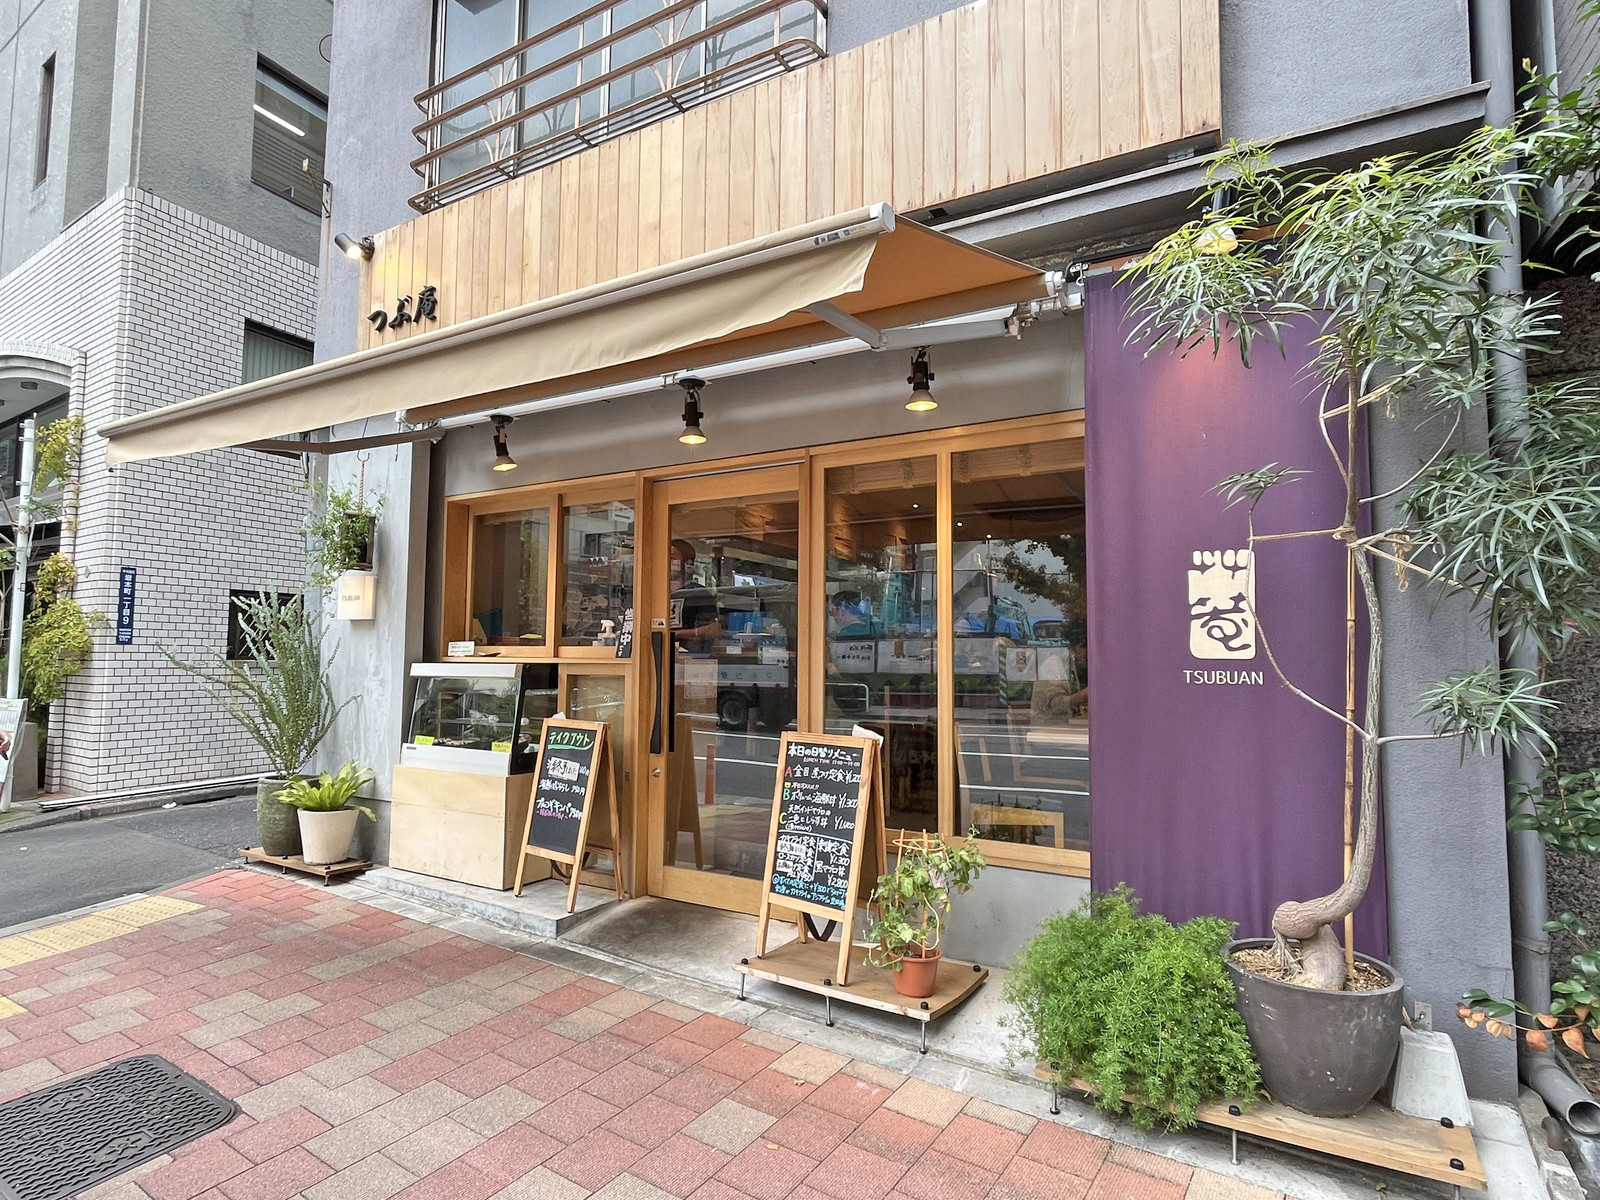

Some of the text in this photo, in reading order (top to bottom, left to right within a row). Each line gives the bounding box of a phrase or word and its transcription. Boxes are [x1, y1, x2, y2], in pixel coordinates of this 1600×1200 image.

[367, 285, 438, 333] つぶ庵
[1183, 670, 1264, 685] TSUBUAN
[549, 731, 591, 747] テイクアウト
[788, 743, 861, 761] 本日の日替りメニュー
[784, 766, 793, 778] A
[783, 789, 791, 801] B
[779, 812, 788, 824] C
